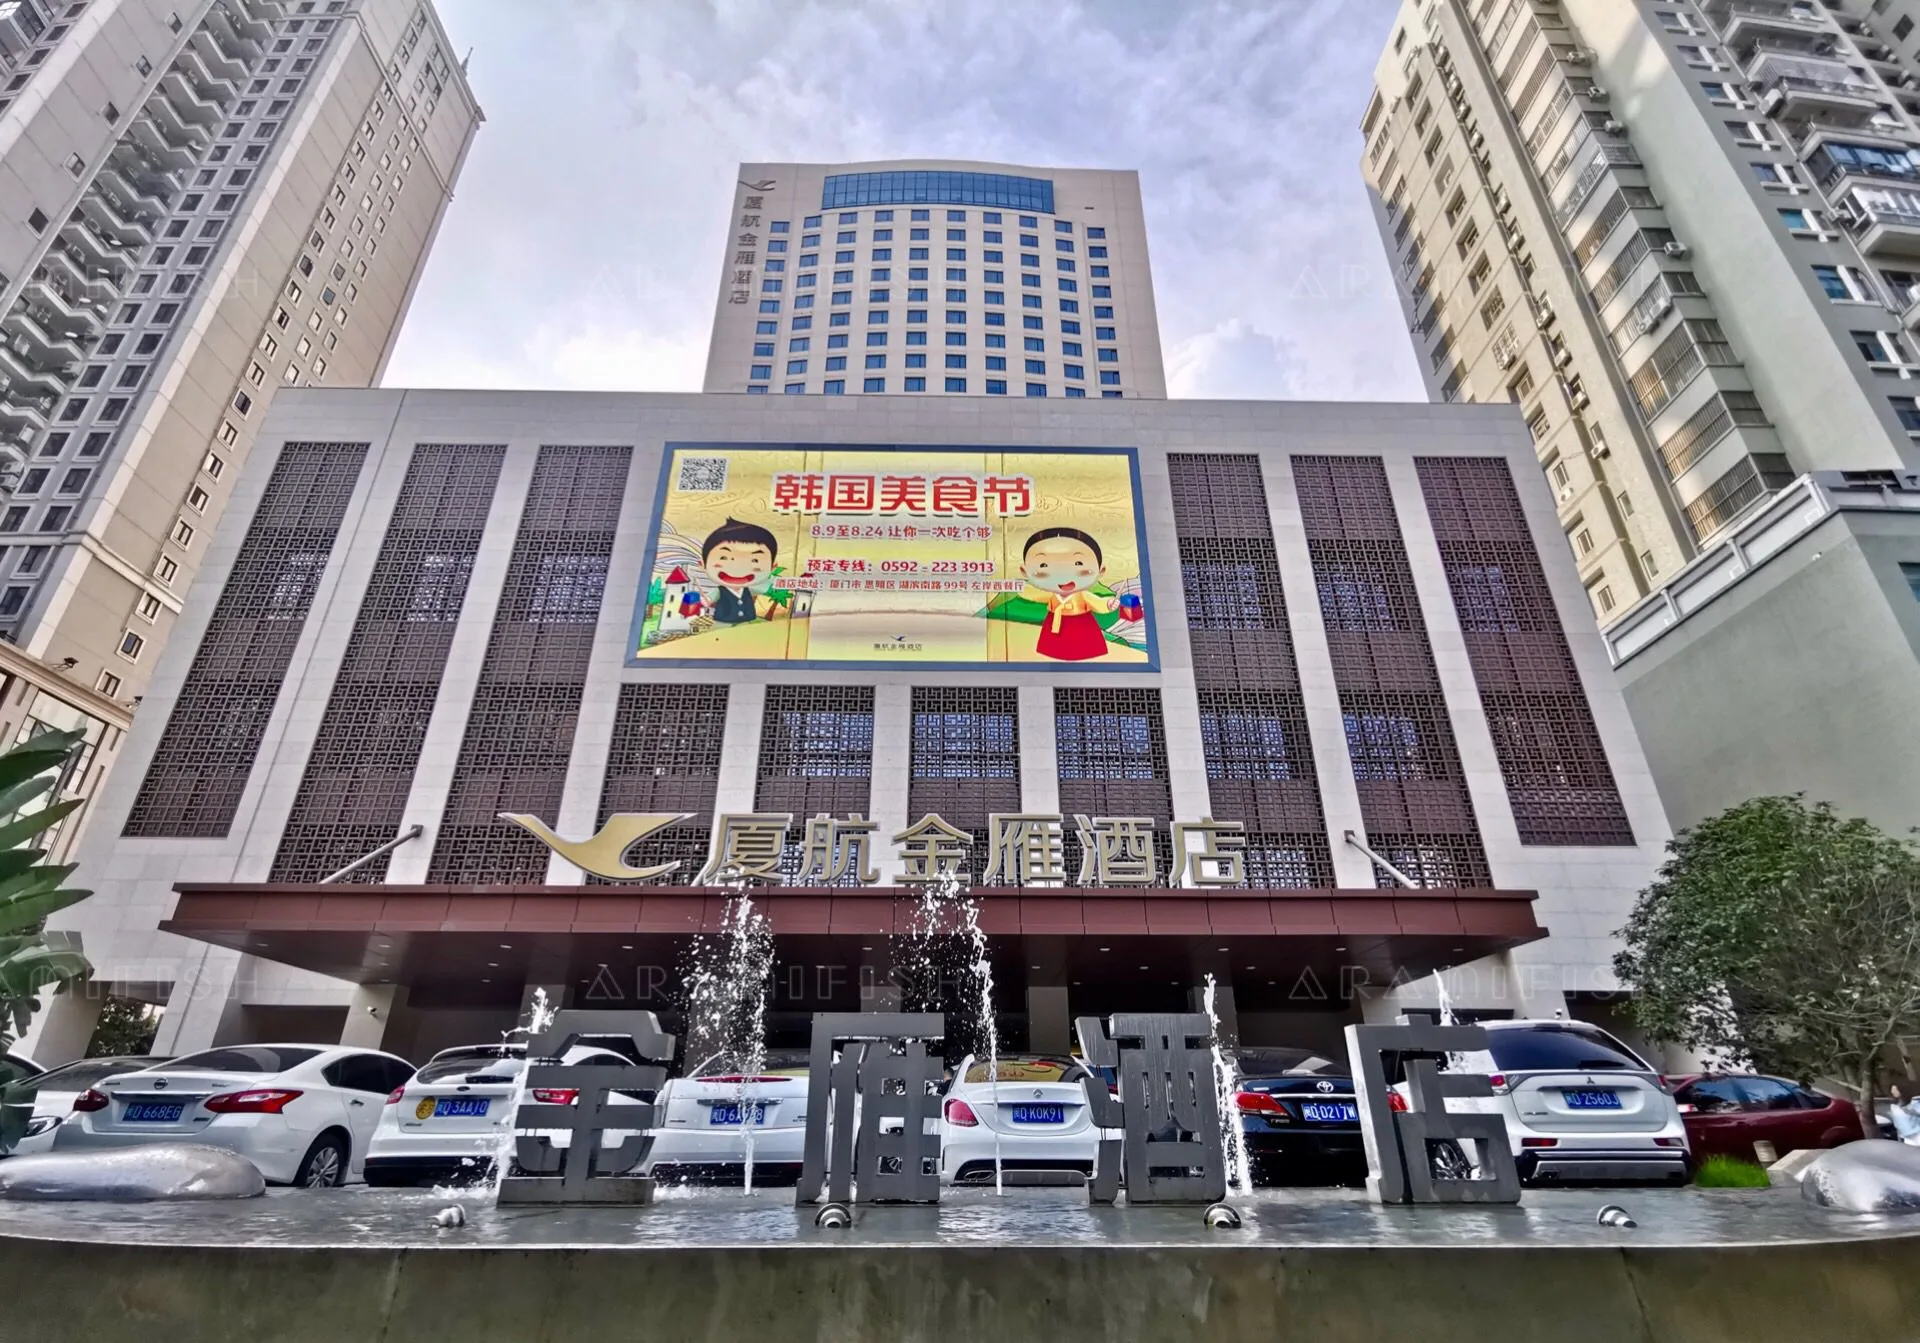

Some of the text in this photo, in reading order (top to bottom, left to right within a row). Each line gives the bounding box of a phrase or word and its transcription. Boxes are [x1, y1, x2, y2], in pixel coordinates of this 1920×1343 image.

[773, 474, 1031, 514] 韩国美食节
[811, 525, 991, 538] 8.9至8.24 让你一次吃个够
[881, 561, 918, 572] 0592
[699, 812, 1246, 887] 厦航金雁酒店
[497, 1008, 1521, 1208] 金雁酒店
